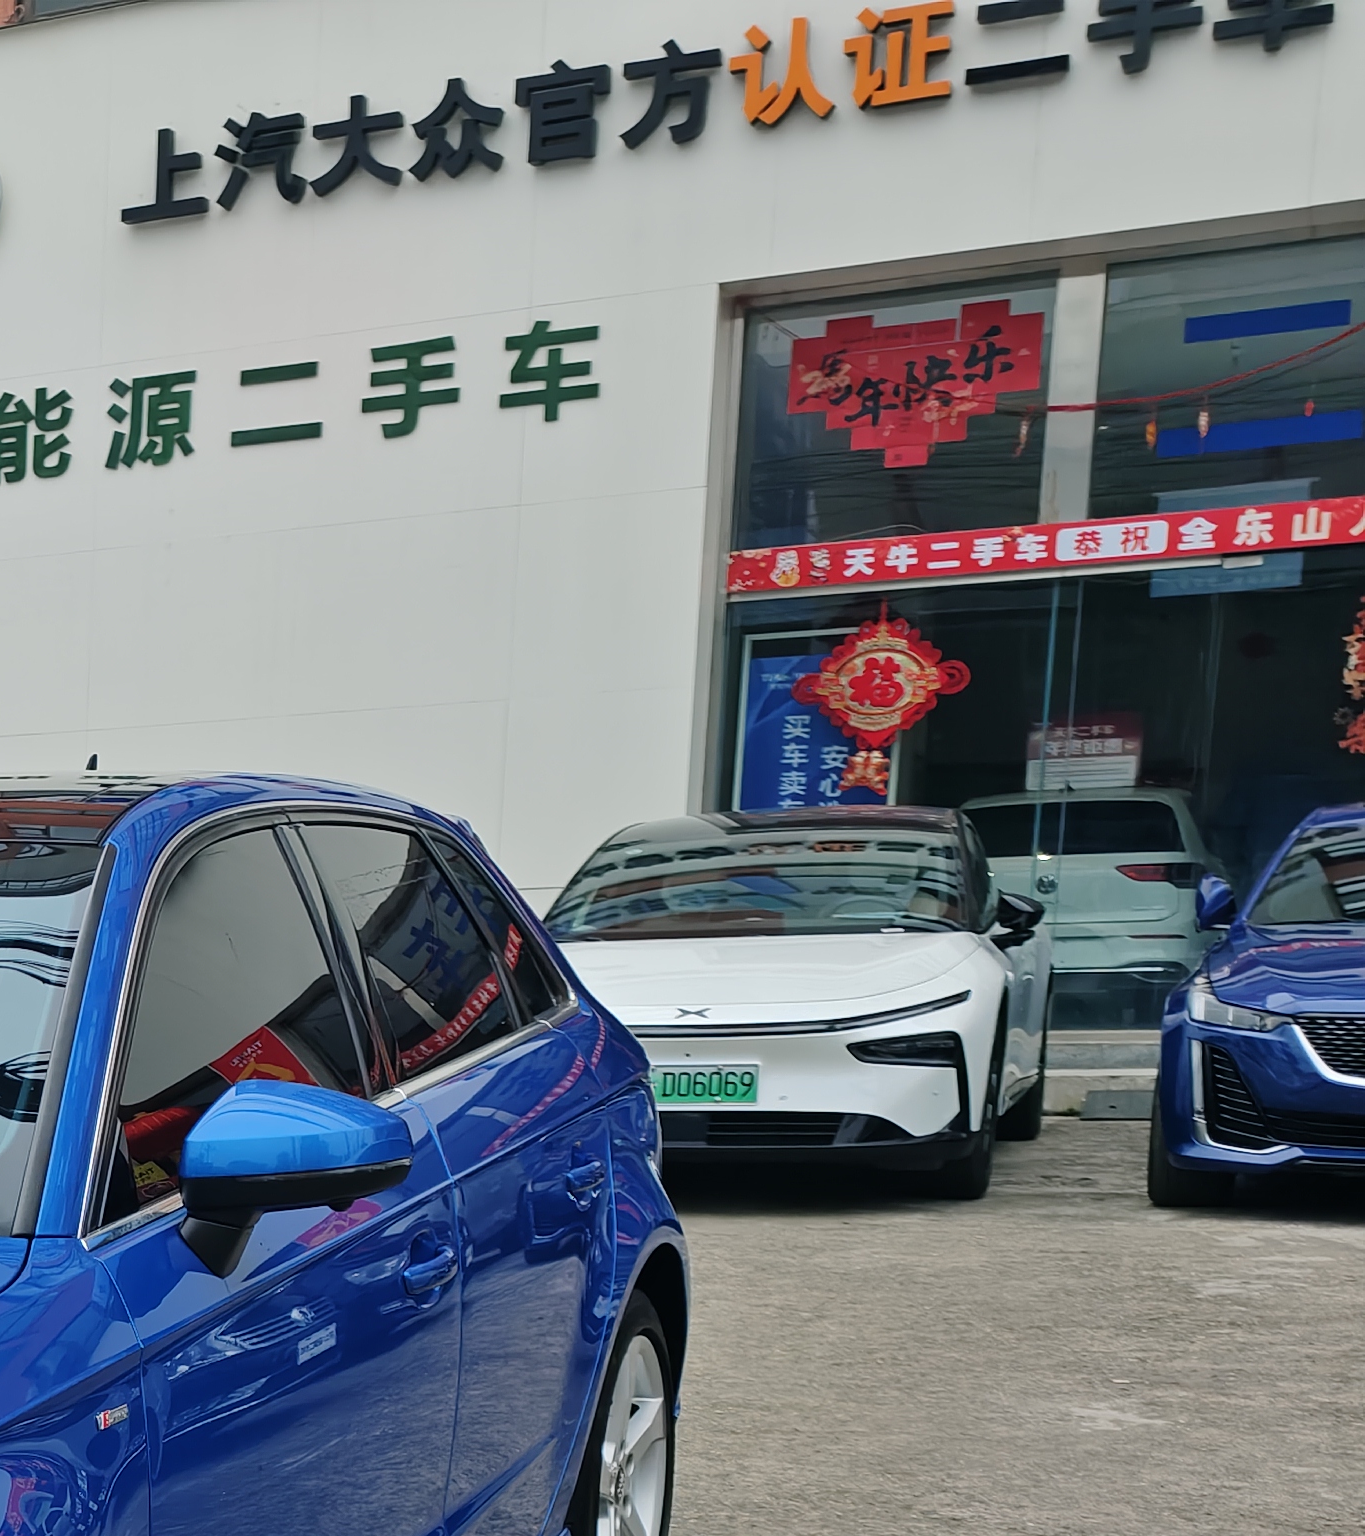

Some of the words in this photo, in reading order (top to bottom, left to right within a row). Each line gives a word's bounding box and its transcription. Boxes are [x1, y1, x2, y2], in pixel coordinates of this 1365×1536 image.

[843, 533, 1049, 577] 天牛二手车
[1073, 525, 1151, 557] 恭祝
[848, 656, 904, 707] 福
[818, 745, 850, 806] 安心
[661, 1071, 755, 1098] D06069
